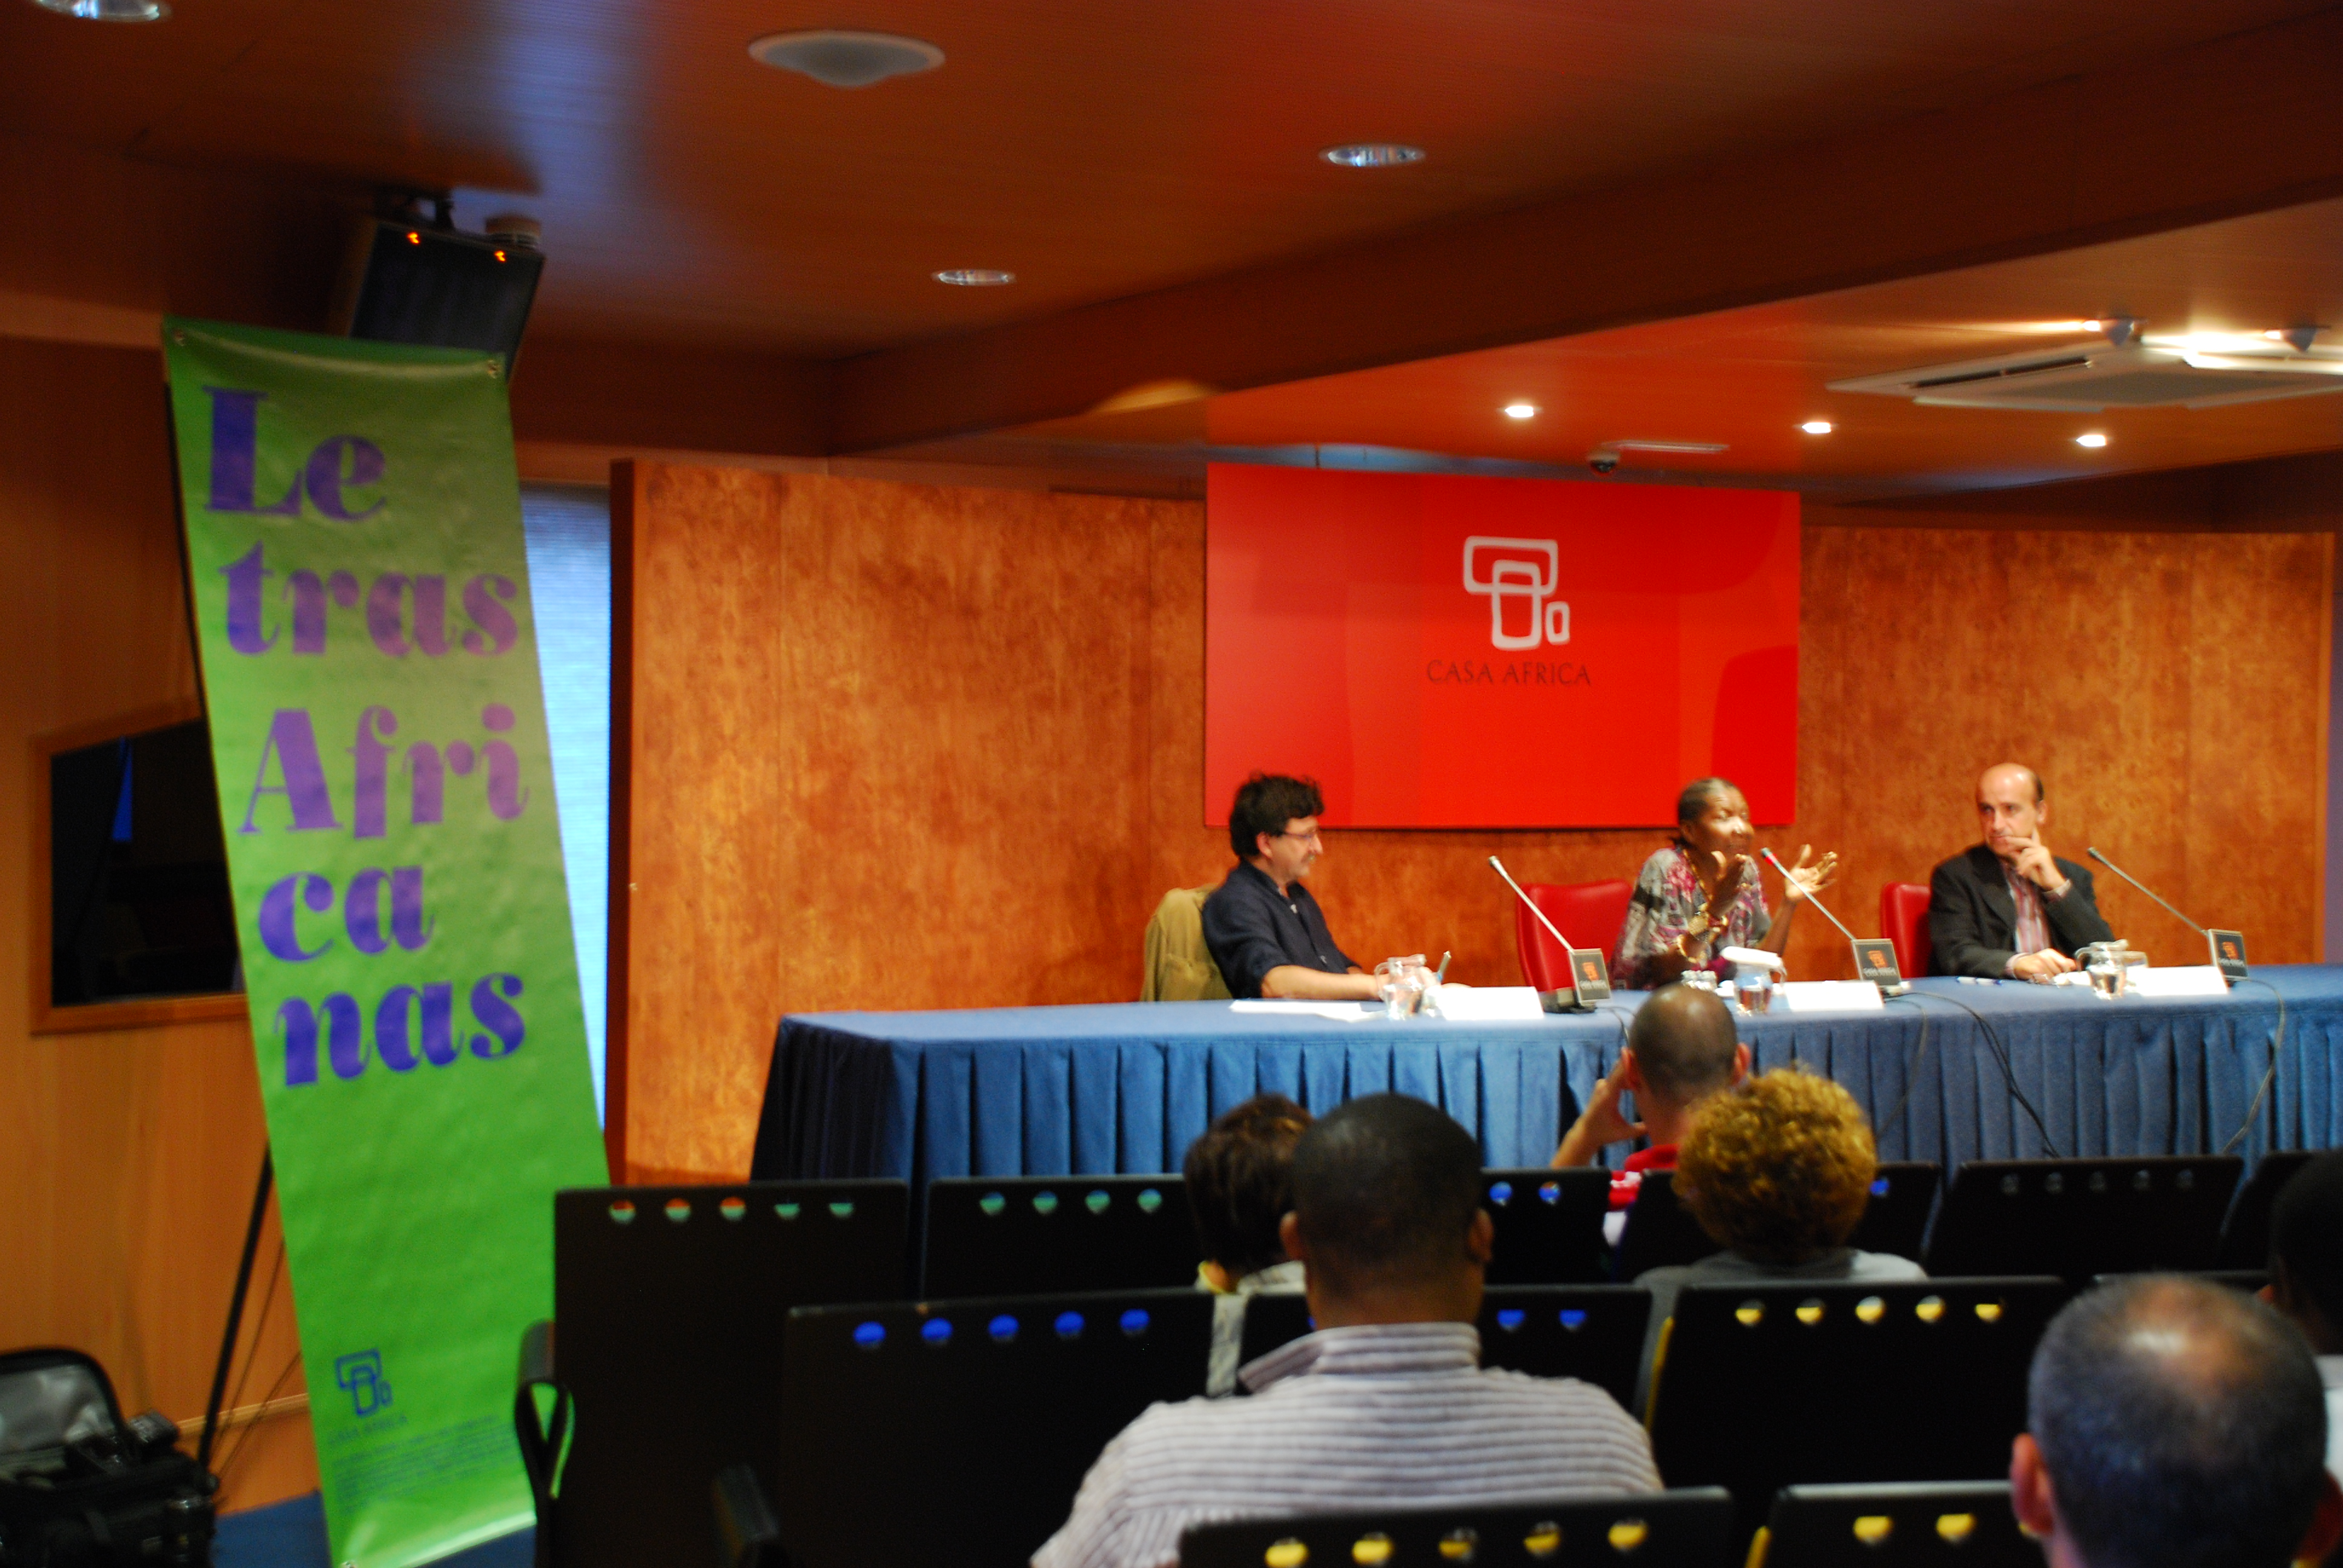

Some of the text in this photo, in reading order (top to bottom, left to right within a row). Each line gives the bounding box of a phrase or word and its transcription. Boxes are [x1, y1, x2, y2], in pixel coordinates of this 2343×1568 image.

[202, 385, 387, 521] Le
[217, 540, 519, 658] tras
[1427, 659, 1592, 687] CASA AFRICA
[238, 702, 530, 841] Afri
[257, 864, 434, 964] ca
[274, 972, 526, 1086] nas
